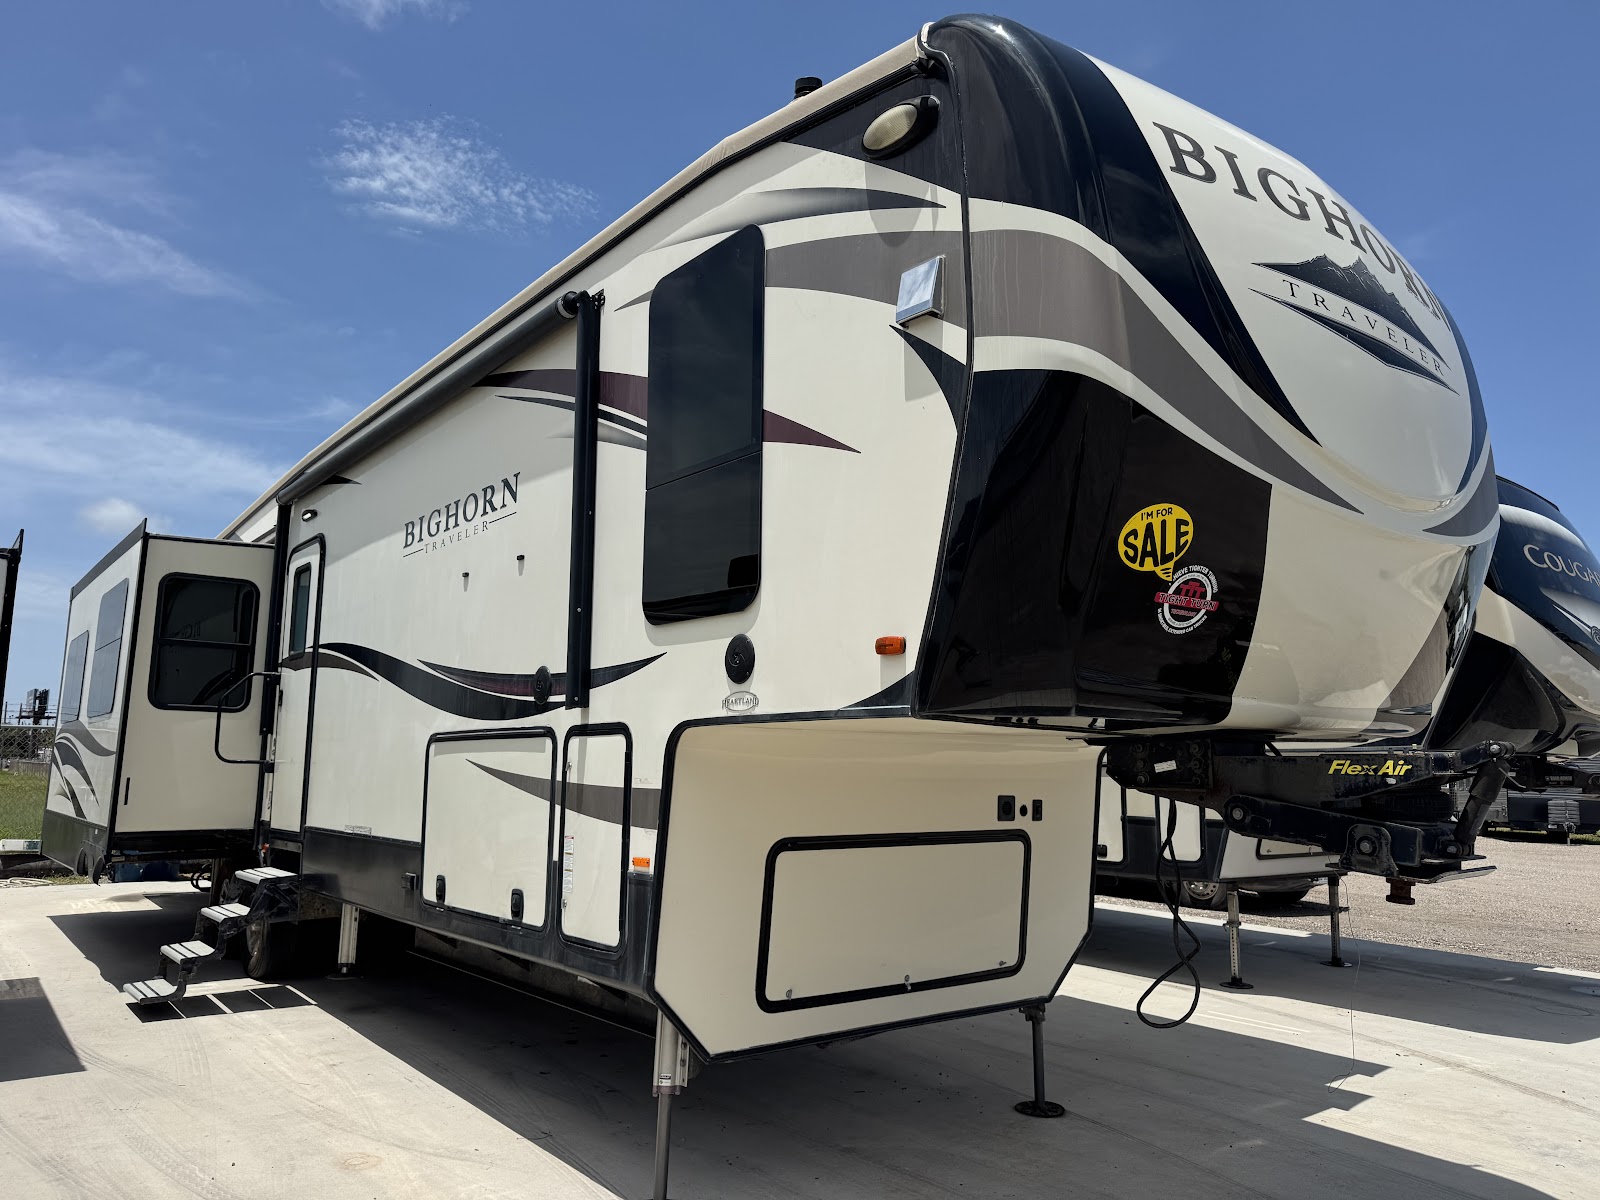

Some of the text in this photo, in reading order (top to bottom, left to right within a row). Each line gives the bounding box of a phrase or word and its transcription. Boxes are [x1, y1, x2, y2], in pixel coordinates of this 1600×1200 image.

[1152, 121, 1451, 332] BIGHORN
[1282, 279, 1443, 376] TRAVELER
[402, 471, 520, 549] BIGHORN
[1141, 507, 1173, 521] I'M FOR
[424, 520, 489, 554] TRAVELER
[1123, 518, 1190, 568] SALE
[1159, 593, 1217, 611] TIGHT TURN
[721, 697, 760, 710] HEARTLAND
[1328, 759, 1413, 776] Flex Air
